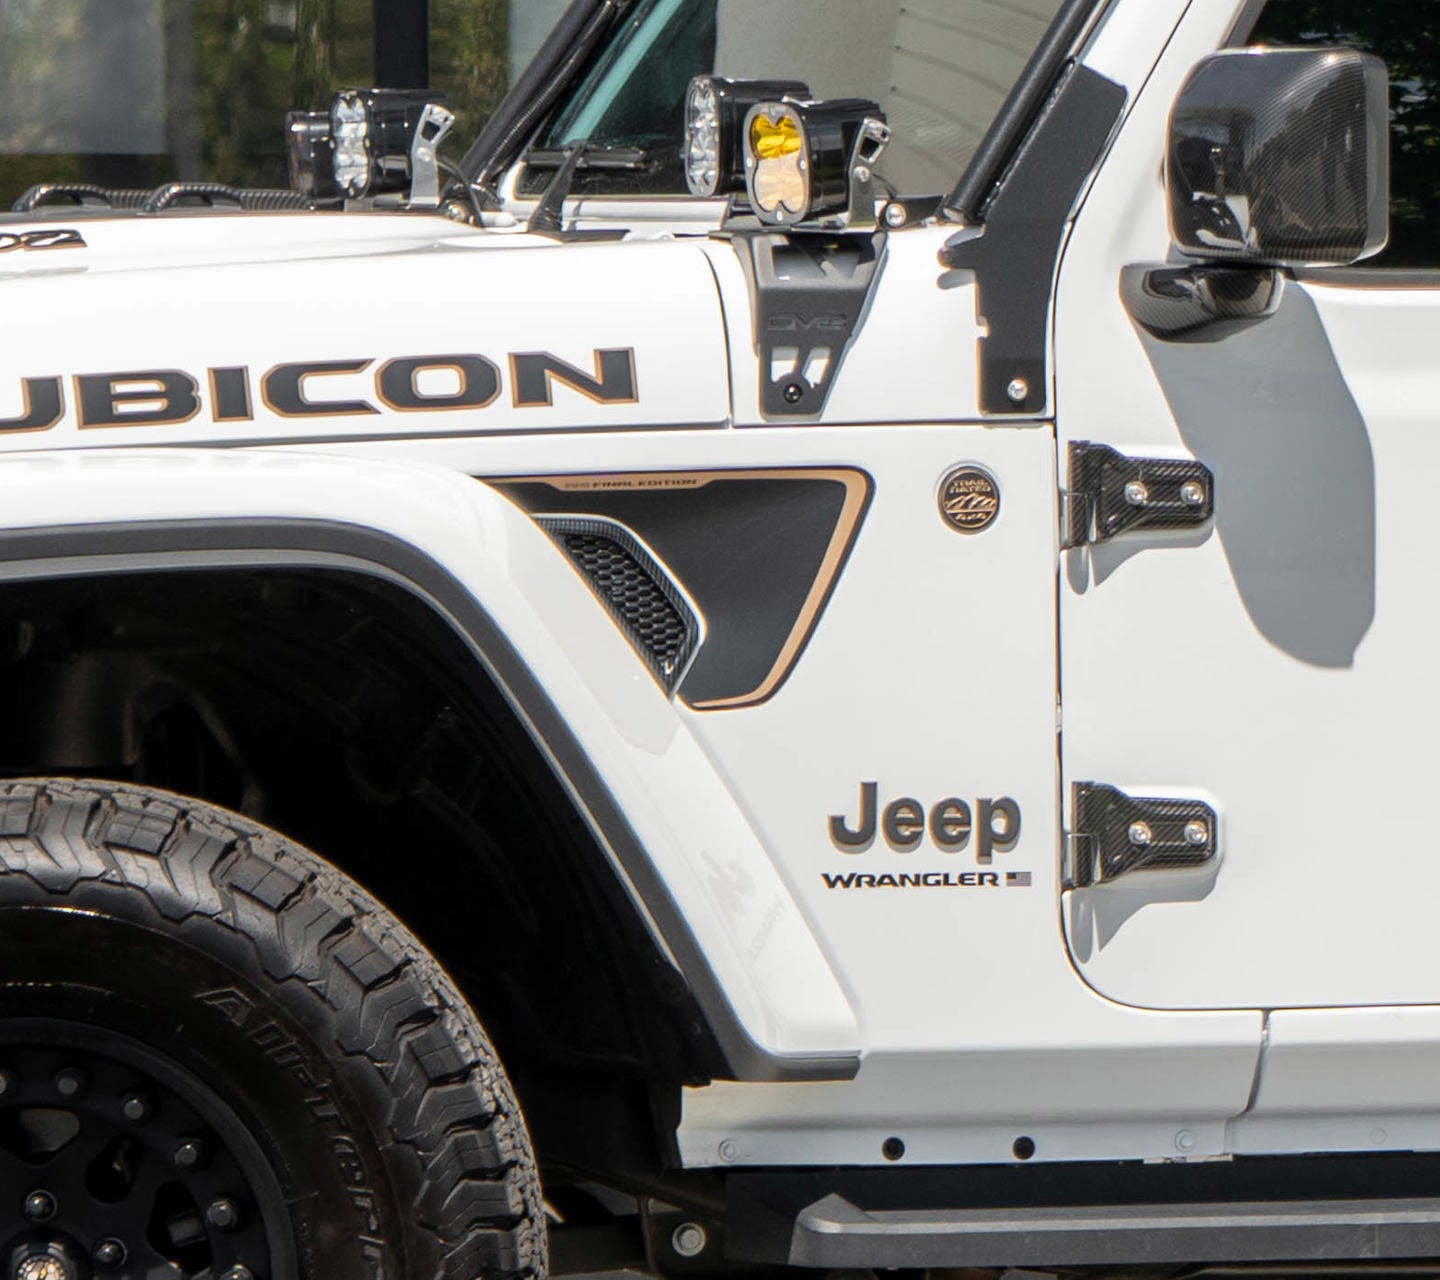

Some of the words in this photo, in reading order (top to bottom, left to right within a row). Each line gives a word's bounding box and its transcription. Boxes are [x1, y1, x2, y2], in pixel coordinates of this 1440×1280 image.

[592, 480, 634, 488] FINAL
[950, 486, 991, 494] RATED
[828, 781, 1021, 862] Jeep
[821, 872, 1000, 889] WRANGLER
